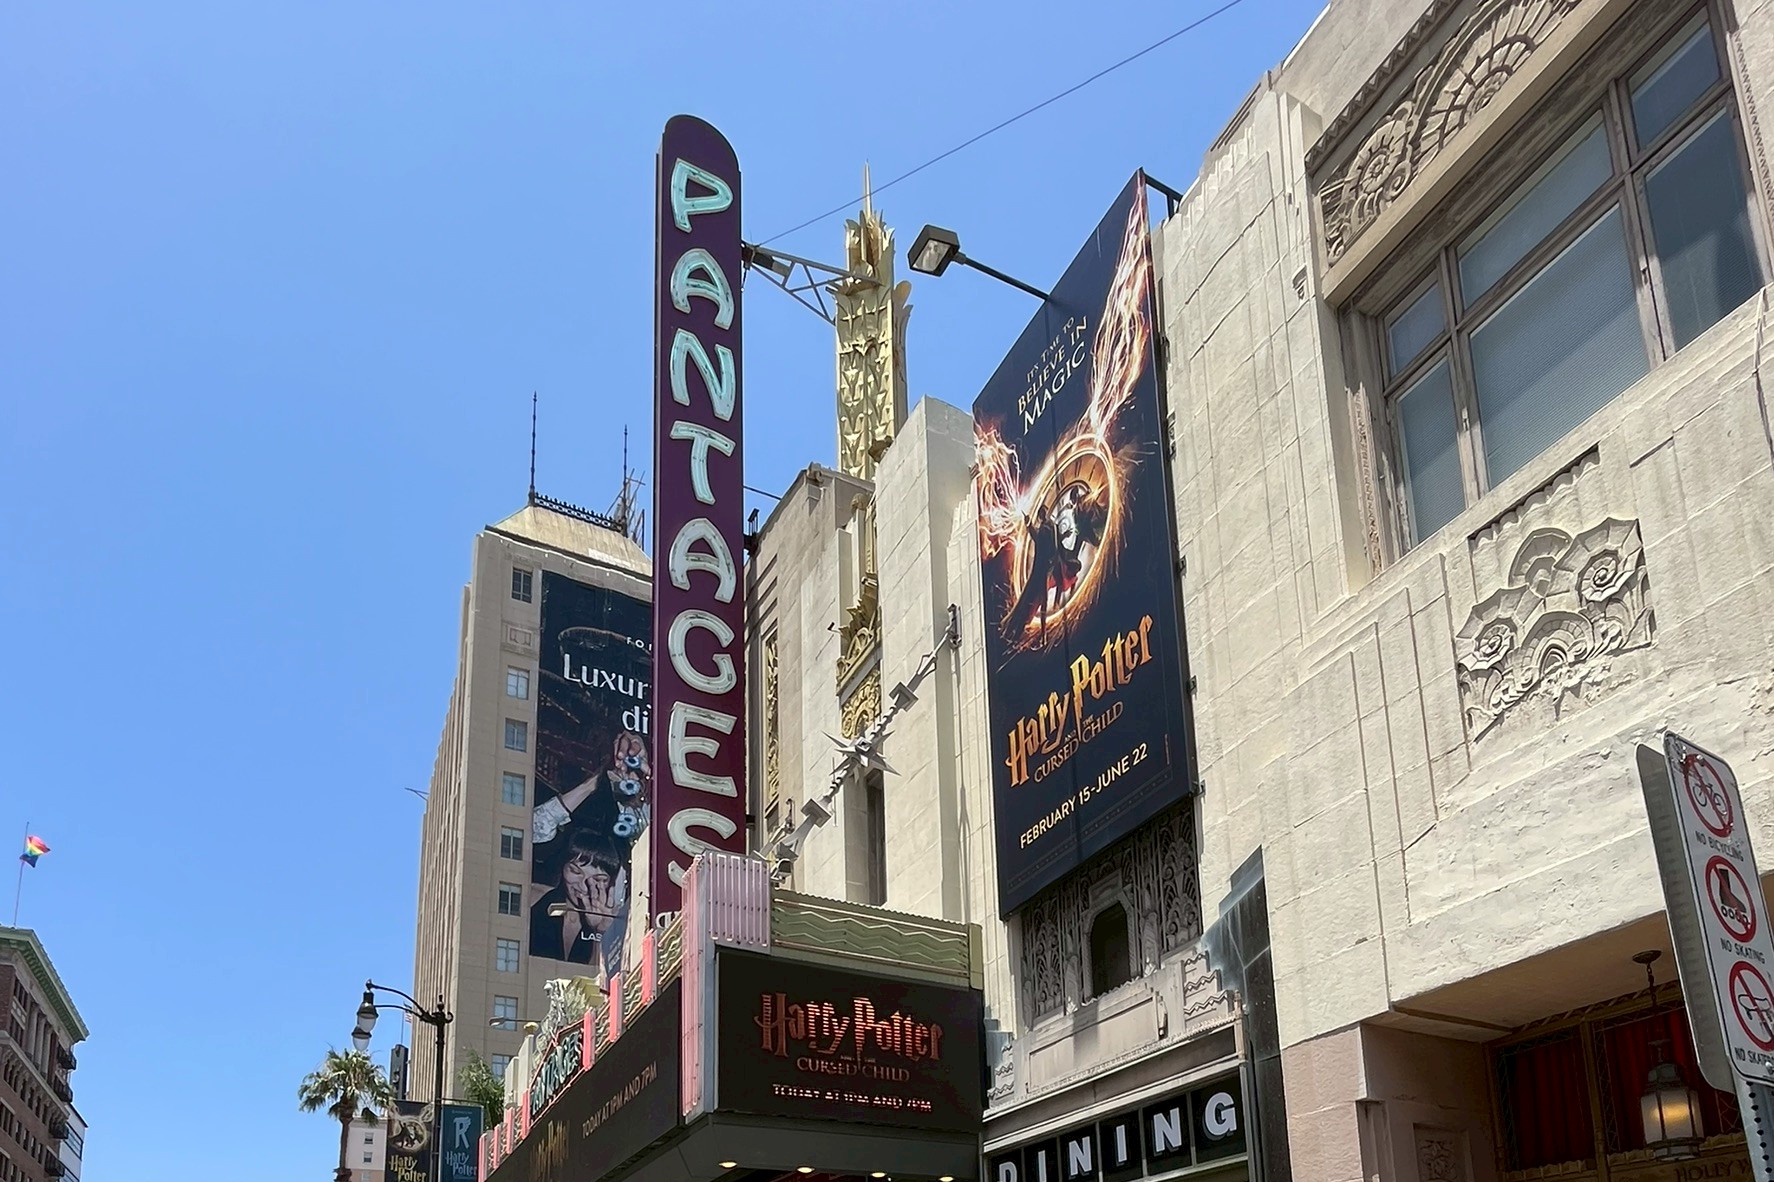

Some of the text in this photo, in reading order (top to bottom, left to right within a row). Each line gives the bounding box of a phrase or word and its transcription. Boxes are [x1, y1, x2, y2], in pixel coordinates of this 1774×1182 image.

[1062, 317, 1074, 333] TO
[1018, 316, 1087, 416] BELIEVE IN
[1023, 341, 1086, 436] MAGIC
[669, 157, 738, 888] PANTAGES
[563, 653, 652, 700] Luxur
[622, 704, 652, 735] di
[1005, 614, 1154, 787] Harry Potter
[1034, 701, 1124, 783] CURSED CHILD
[1020, 796, 1076, 849] FEBRUARY
[1132, 743, 1148, 765] 22
[1695, 830, 1744, 862] NO BICYCLING
[581, 931, 602, 942] LAS
[1720, 938, 1766, 964] NO SKATING
[754, 993, 944, 1071] Harry Potter
[797, 1056, 911, 1082] CURSED CHILD
[1734, 1047, 1745, 1061] NO
[583, 1109, 600, 1140] TODAY
[624, 1074, 641, 1105] AND
[389, 1155, 417, 1171] Harry
[445, 1151, 469, 1166] Harry
